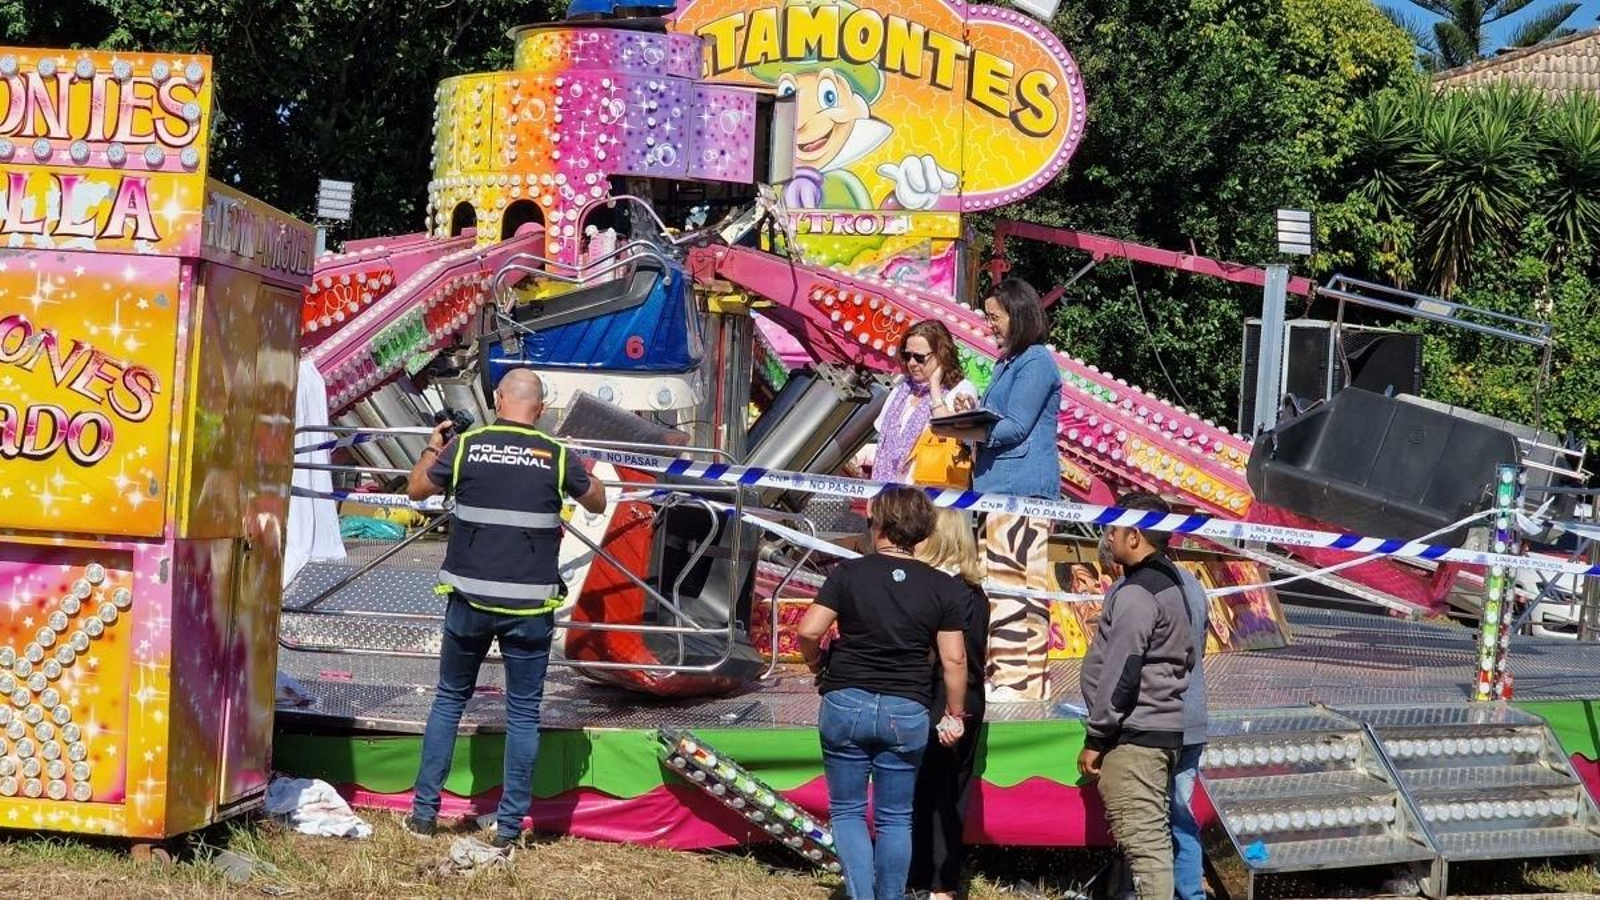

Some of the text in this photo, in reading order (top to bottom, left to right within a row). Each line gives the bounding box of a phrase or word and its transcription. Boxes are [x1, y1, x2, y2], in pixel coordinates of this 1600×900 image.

[694, 4, 1061, 138] TAMONTES
[625, 335, 645, 359] 6
[469, 444, 534, 457] POLICIA
[467, 453, 552, 470] NACIONAL
[607, 452, 660, 468] NO PASAR
[768, 474, 790, 482] CNP
[809, 480, 825, 490] NO
[829, 483, 865, 495] PASAR
[980, 500, 1003, 509] CNP
[1023, 506, 1081, 520] NO PASAR
[1249, 533, 1312, 546] NO PASAR
